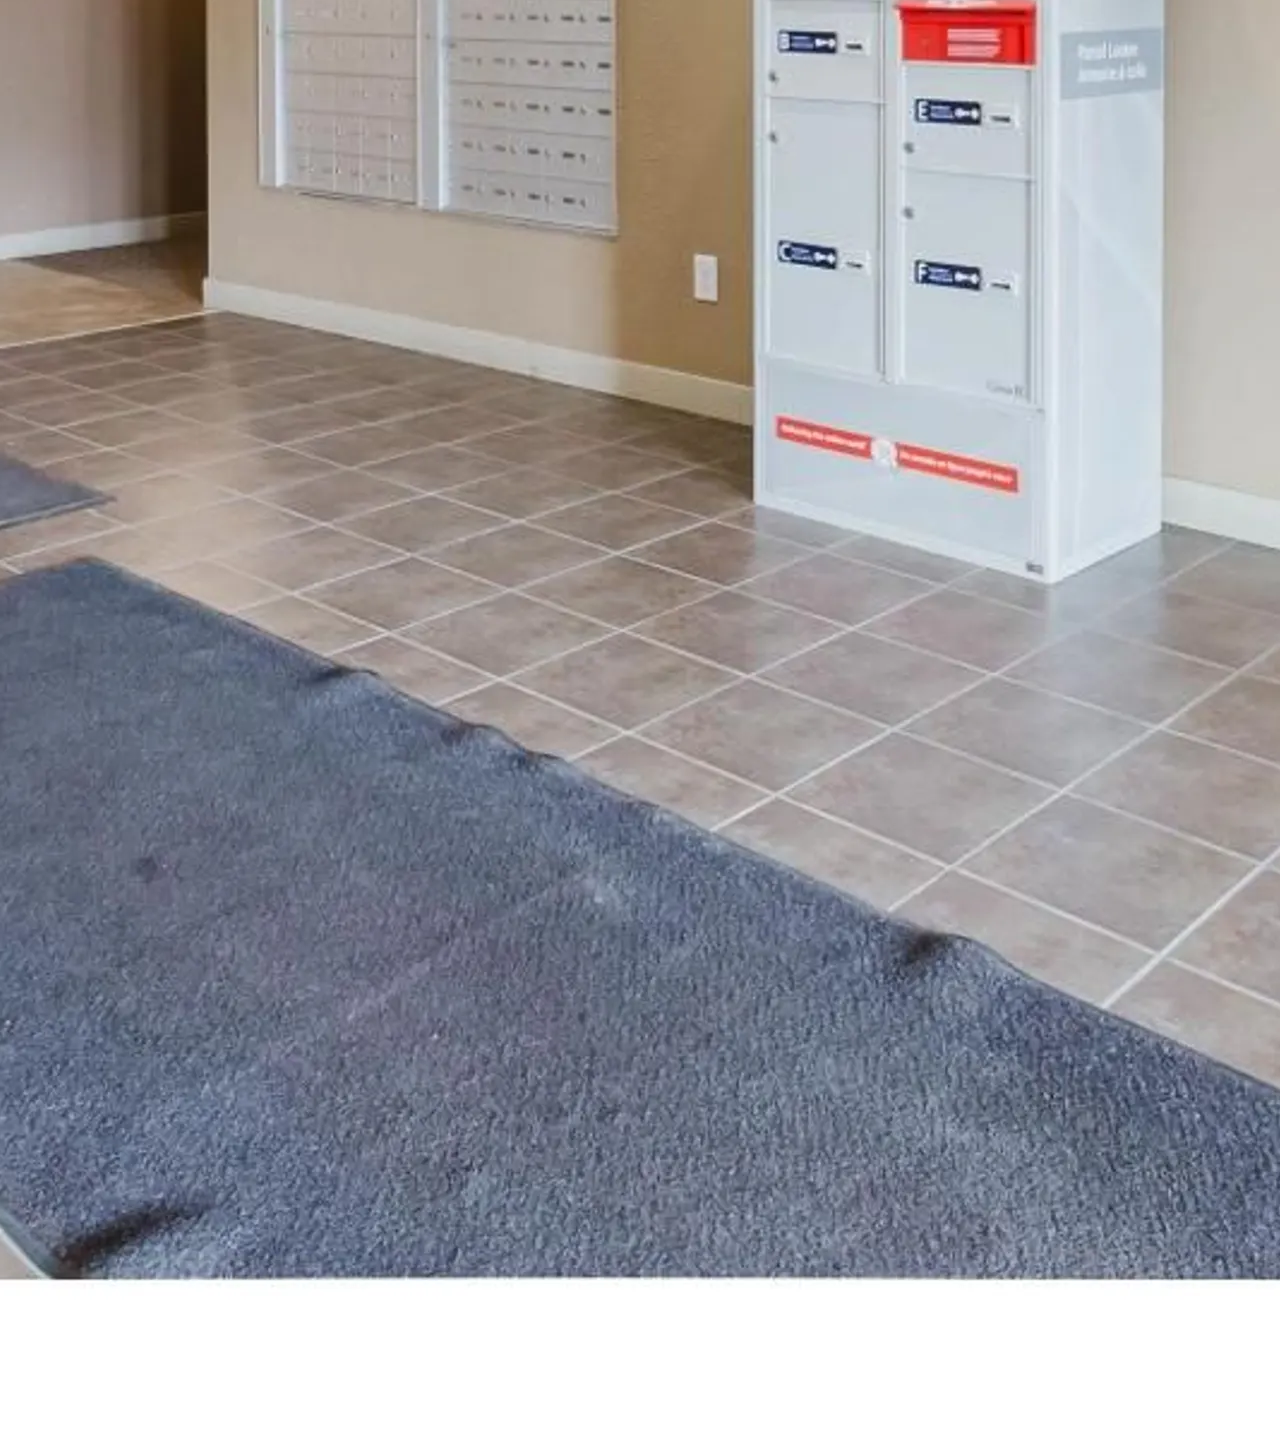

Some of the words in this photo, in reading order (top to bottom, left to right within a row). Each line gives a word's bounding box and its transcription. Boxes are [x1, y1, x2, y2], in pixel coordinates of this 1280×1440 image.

[918, 101, 929, 121] E
[779, 242, 792, 261] C
[919, 263, 930, 284] F
